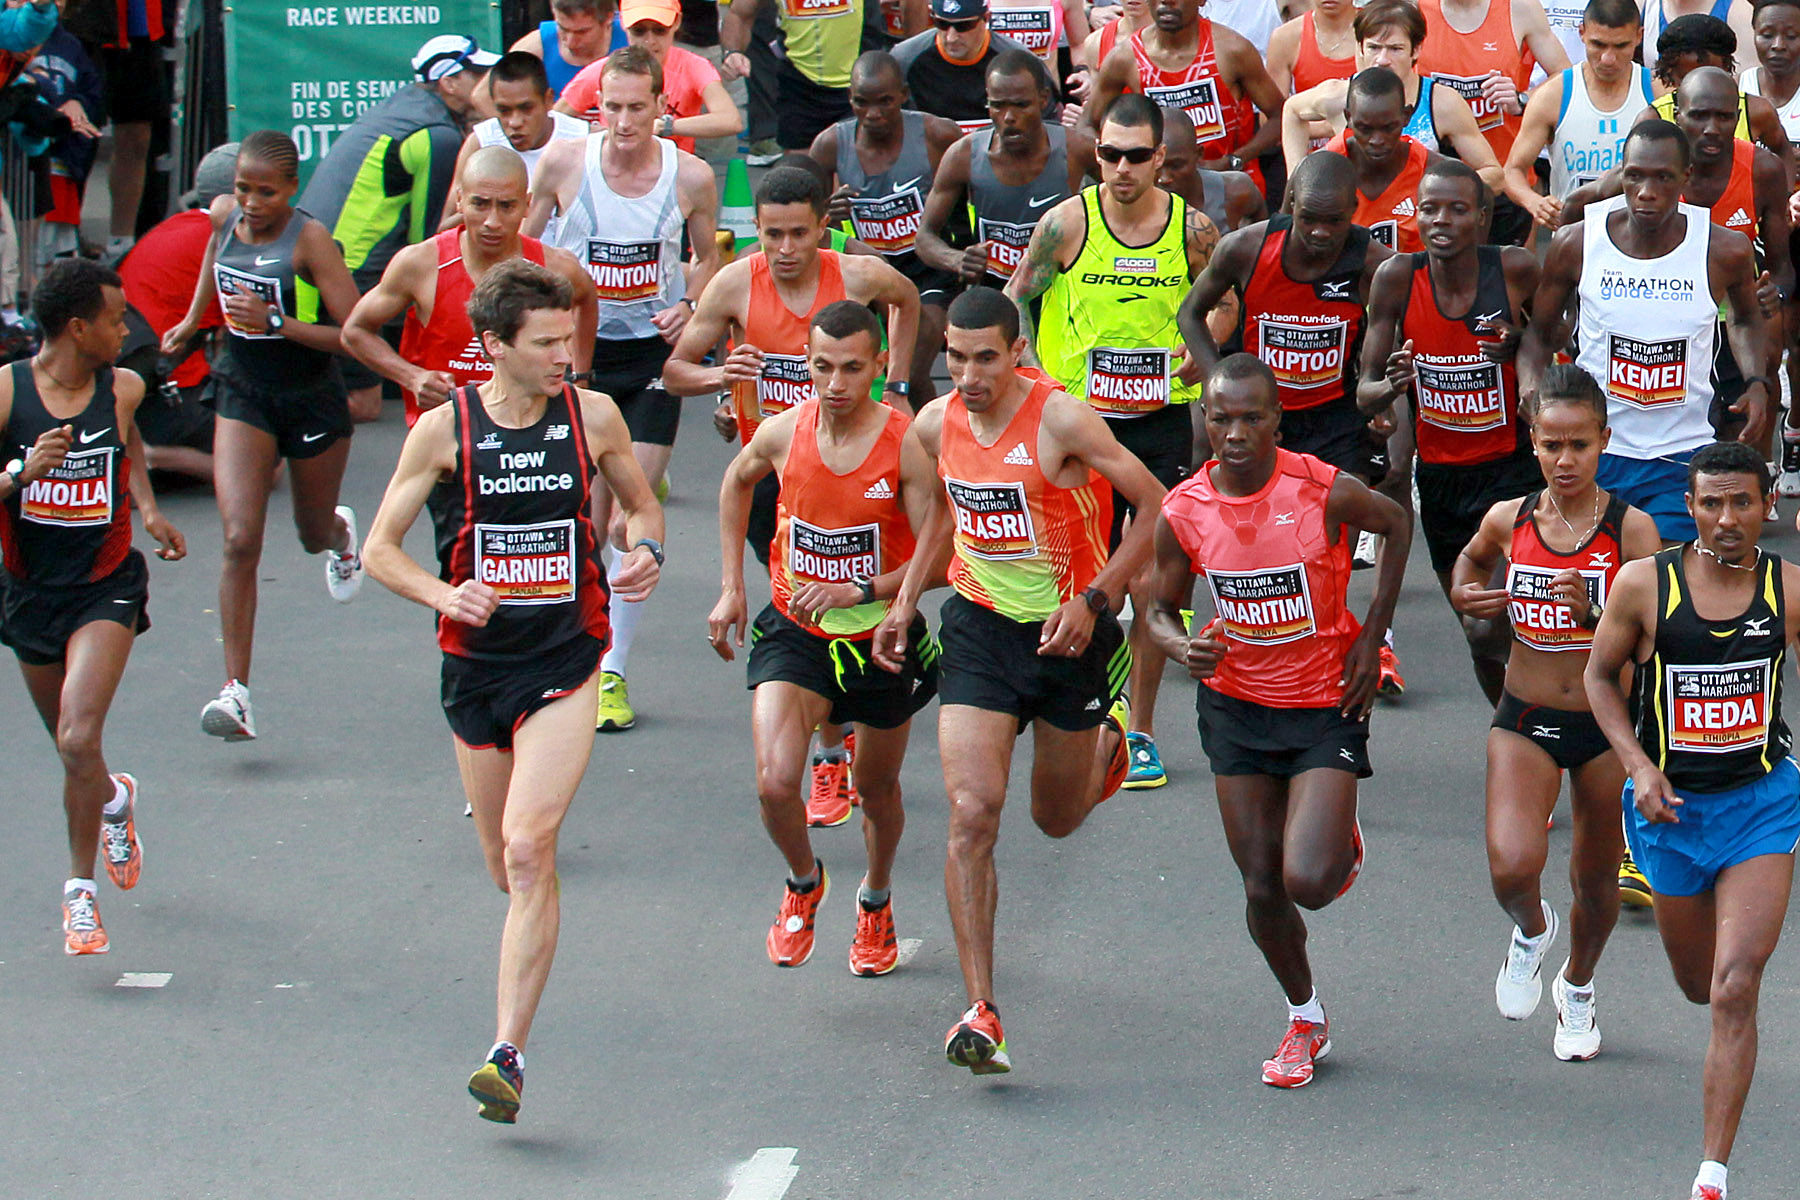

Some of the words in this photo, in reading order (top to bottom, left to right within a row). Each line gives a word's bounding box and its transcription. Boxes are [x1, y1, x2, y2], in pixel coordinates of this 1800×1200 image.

[287, 9, 338, 27] RACE
[345, 7, 440, 25] WEEKEND
[292, 82, 321, 99] FIN
[327, 81, 350, 99] DE
[292, 101, 331, 119] DES
[869, 202, 895, 211] OTTAWA
[861, 212, 921, 240] KIPLAGAT
[610, 246, 639, 254] OTTAWA
[588, 264, 658, 288] WINTON
[1080, 273, 1182, 288] BROOKS
[1599, 277, 1695, 290] MARATHON
[1600, 284, 1694, 302] guide.com
[1272, 313, 1298, 323] team
[1301, 313, 1341, 324] run-fast
[1286, 331, 1320, 340] OTTAWA
[1286, 339, 1330, 349] MARATHON
[1632, 344, 1663, 354] OTTAWA
[1112, 356, 1142, 365] OTTAWA
[1265, 346, 1339, 372] KIPTOO
[1425, 354, 1454, 363] team
[1631, 352, 1674, 364] MARATHON
[1111, 364, 1152, 374] MARATHON
[1438, 371, 1472, 381] OTTAWA
[1612, 360, 1682, 391] KEMEI
[1091, 374, 1164, 400] CHIASSON
[1439, 380, 1485, 390] MARATHON
[1422, 389, 1499, 414] BARTALE
[500, 451, 546, 470] new
[1003, 456, 1032, 466] adidas
[479, 472, 573, 495] balance
[964, 490, 995, 501] OTTAWA
[967, 498, 1009, 511] MARATHON
[959, 507, 1027, 539] ELASRI
[507, 532, 545, 544] OTTAWA
[813, 534, 848, 545] OTTAWA
[507, 542, 557, 554] MARATHON
[814, 541, 861, 553] MARATHON
[482, 556, 569, 584] GARNIER
[795, 551, 876, 581] BOUBKER
[1236, 577, 1273, 588] OTTAWA
[510, 587, 543, 595] CANADA
[1237, 585, 1288, 598] MARATHON
[1220, 596, 1305, 625] MARITIM
[1252, 628, 1277, 636] KENYA
[1535, 632, 1572, 642] ETHIOPIA
[1701, 672, 1739, 685] OTTAWA
[1701, 682, 1752, 697] MARATHON
[1683, 698, 1757, 729] REDA
[1703, 731, 1740, 742] ETHIOPIA
